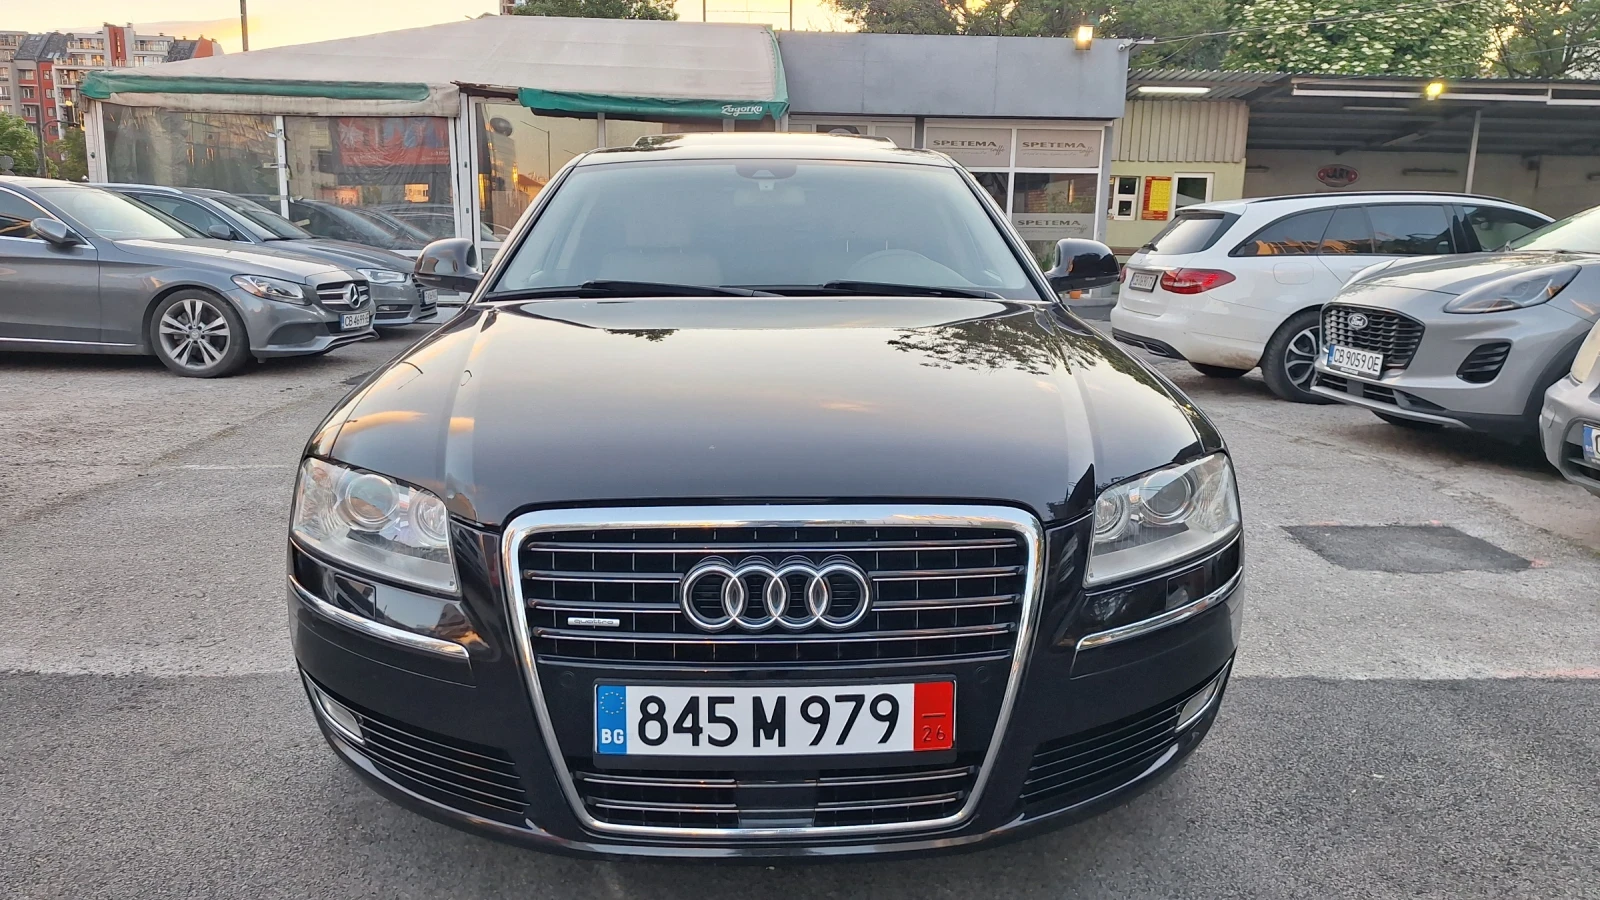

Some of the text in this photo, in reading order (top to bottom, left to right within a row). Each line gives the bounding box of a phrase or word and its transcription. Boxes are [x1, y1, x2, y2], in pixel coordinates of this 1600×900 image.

[721, 104, 763, 117] Zagorka
[933, 139, 997, 147] SPETEMA
[1334, 348, 1345, 364] CB
[1346, 351, 1367, 369] 9059
[1367, 355, 1380, 372] OE
[638, 693, 899, 748] 845 M 979
[601, 728, 624, 745] BG
[922, 724, 946, 743] 26
